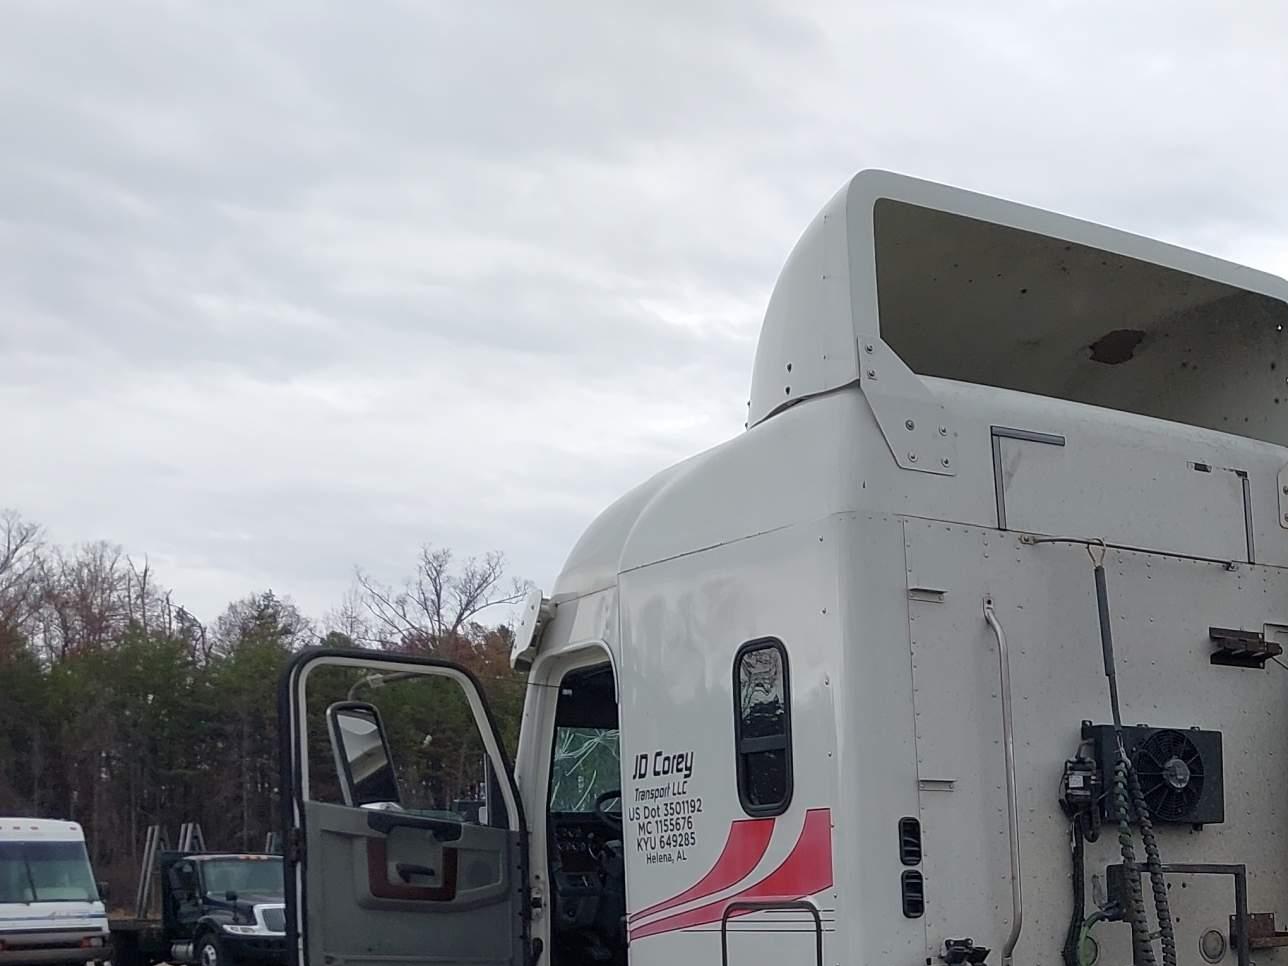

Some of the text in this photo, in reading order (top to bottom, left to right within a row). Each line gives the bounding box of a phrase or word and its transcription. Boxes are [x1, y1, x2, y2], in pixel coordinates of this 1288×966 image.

[632, 751, 694, 780] JD Corey
[635, 781, 688, 802] Transport LLC
[628, 798, 703, 822] US Dot 3501192
[637, 816, 693, 836] MC 1155676
[636, 832, 696, 852] KYU 649285
[646, 850, 688, 865] Helena, AL
